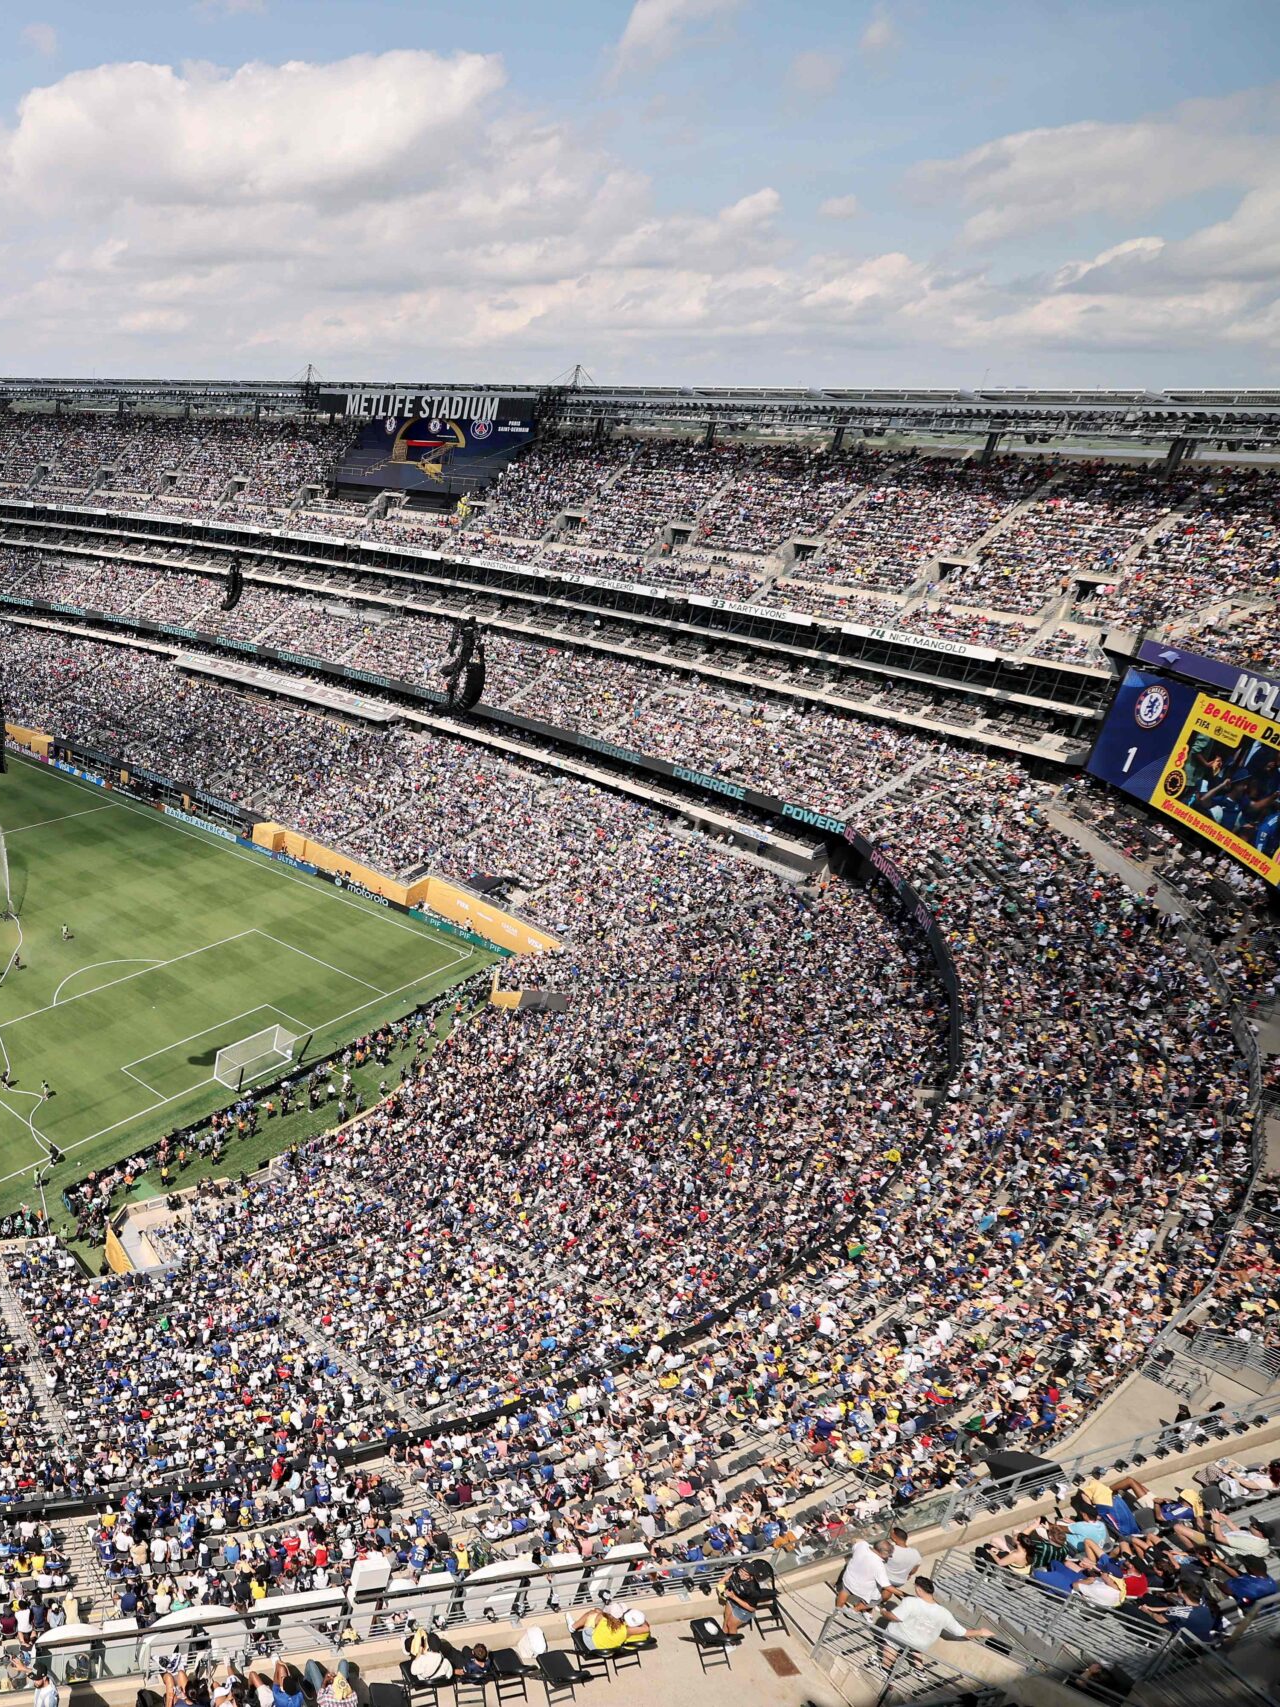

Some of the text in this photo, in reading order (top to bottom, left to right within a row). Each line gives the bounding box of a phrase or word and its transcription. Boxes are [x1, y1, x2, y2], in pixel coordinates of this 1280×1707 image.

[346, 394, 500, 421] METLIFE STADIUM
[480, 560, 507, 570] WINSTON
[508, 564, 520, 572] HILL
[569, 575, 581, 583] 73
[594, 578, 607, 587] JOE
[0, 594, 34, 607] POWERADE
[51, 603, 86, 617] POWERADE
[711, 599, 787, 620] 93 MARTY LYONS
[159, 624, 197, 639] POWERADE
[868, 628, 967, 654] 74 NICK MANGOLD
[216, 637, 258, 653] POWERADE
[277, 651, 322, 670] POWERADE
[343, 667, 391, 688] POWERADE
[414, 686, 449, 704] POWER
[1229, 673, 1280, 722] HCL
[1195, 718, 1211, 730] FIFA
[1203, 702, 1219, 718] Be
[1220, 710, 1259, 734] Active
[1261, 726, 1280, 747] Da
[577, 735, 641, 764] POWERADE
[1122, 747, 1138, 773] 1
[132, 766, 174, 788] POWERADE
[673, 766, 747, 800] POWERADE
[195, 790, 240, 816] POWERADE
[660, 798, 681, 809] verizon
[166, 806, 184, 820] BANK
[194, 818, 226, 837] AMERICA
[1161, 799, 1175, 811] Kids
[1174, 806, 1189, 820] need
[1200, 821, 1217, 838] active
[1229, 842, 1252, 861] minutes
[1250, 857, 1261, 868] per
[1260, 862, 1271, 875] day
[277, 854, 297, 868] ULTRA
[347, 884, 389, 907] motorola
[430, 918, 441, 928] PIF
[459, 930, 471, 940] PIF
[489, 943, 502, 953] PIF
